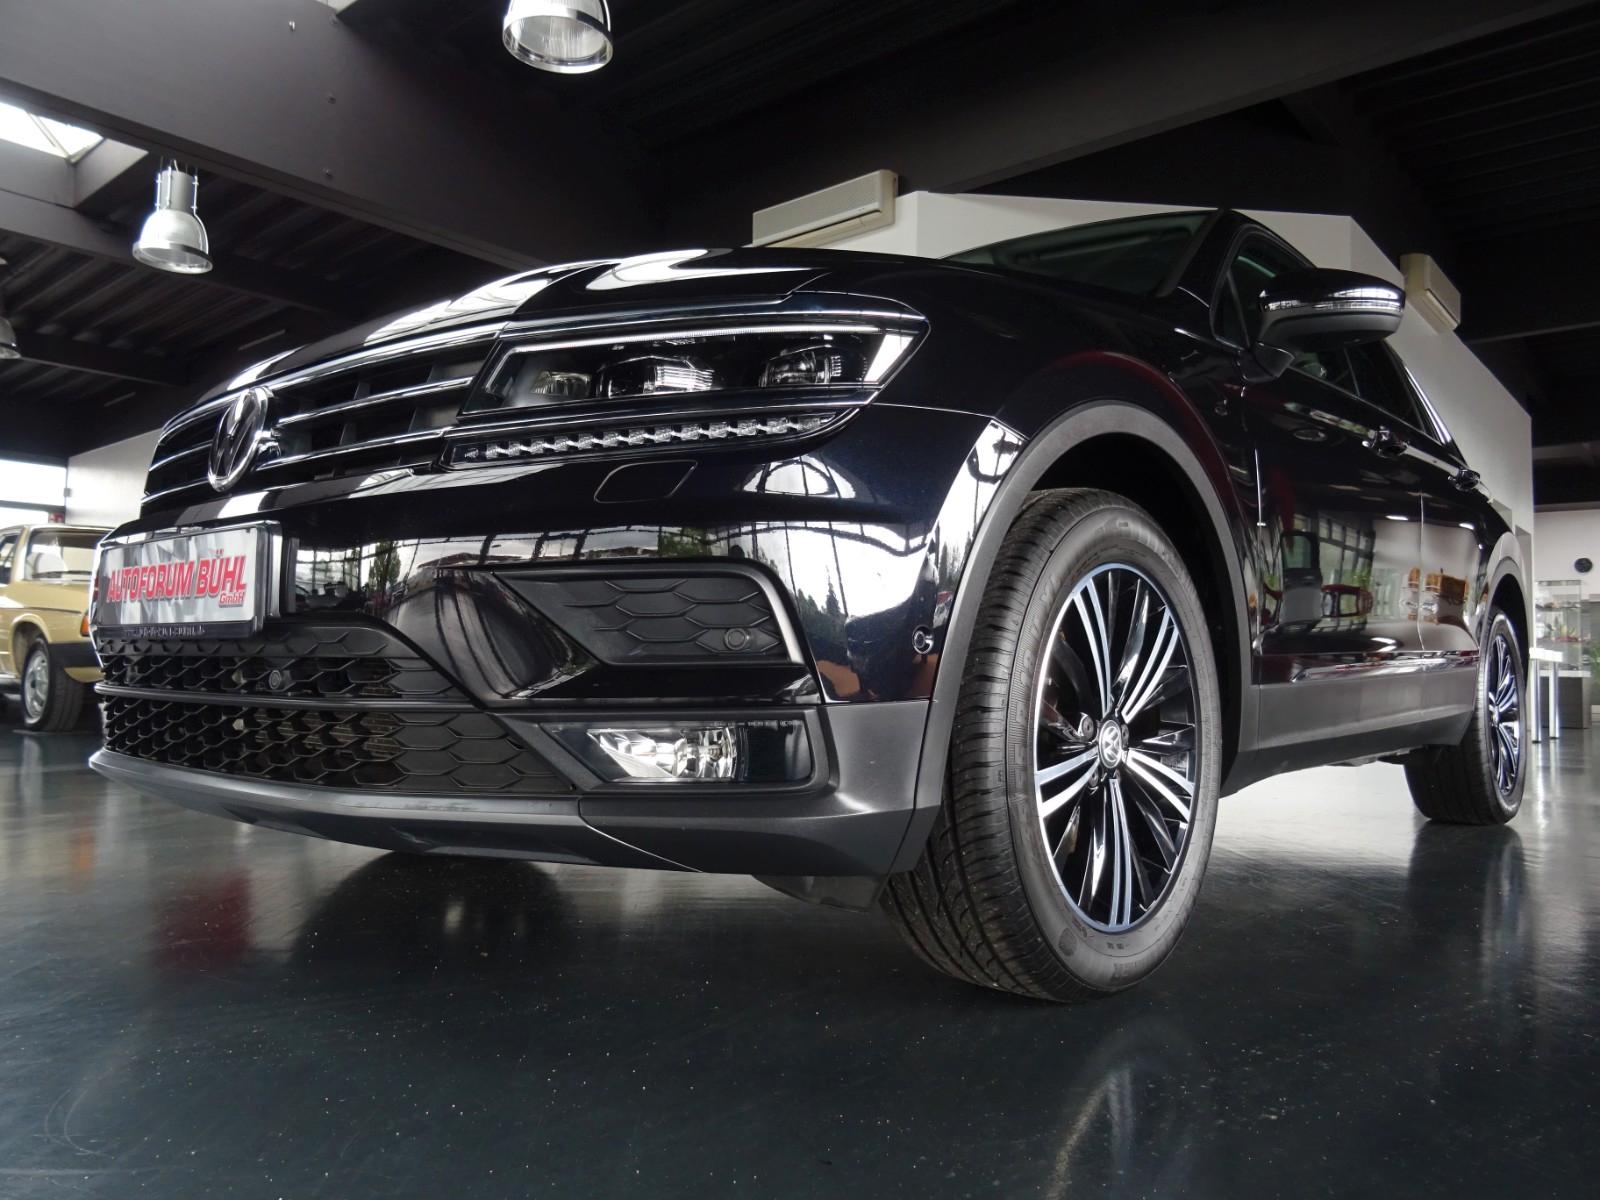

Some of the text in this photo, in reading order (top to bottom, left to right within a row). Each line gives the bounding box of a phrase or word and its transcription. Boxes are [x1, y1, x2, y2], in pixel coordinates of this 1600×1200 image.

[108, 549, 247, 602] AUTOFORUM BÜHL
[218, 590, 246, 608] GmbH
